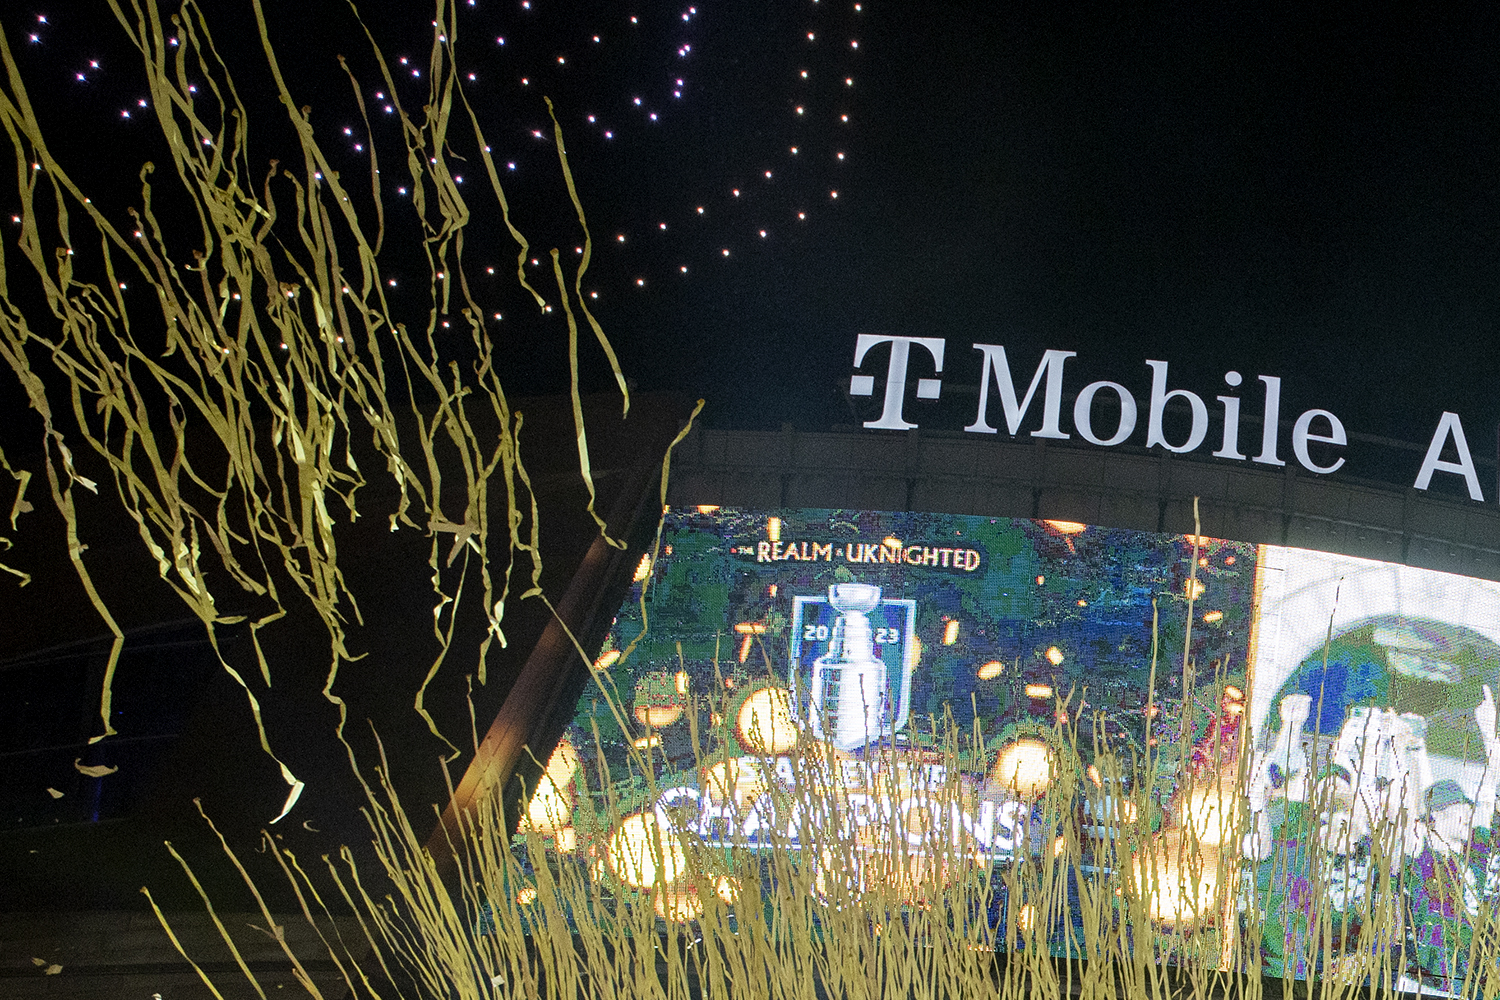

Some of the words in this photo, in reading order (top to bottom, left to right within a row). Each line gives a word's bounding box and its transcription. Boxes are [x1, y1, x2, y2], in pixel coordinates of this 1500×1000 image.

[964, 343, 1347, 474] Mobile
[757, 541, 833, 562] REALM
[803, 625, 828, 641] 20
[875, 628, 900, 644] 23
